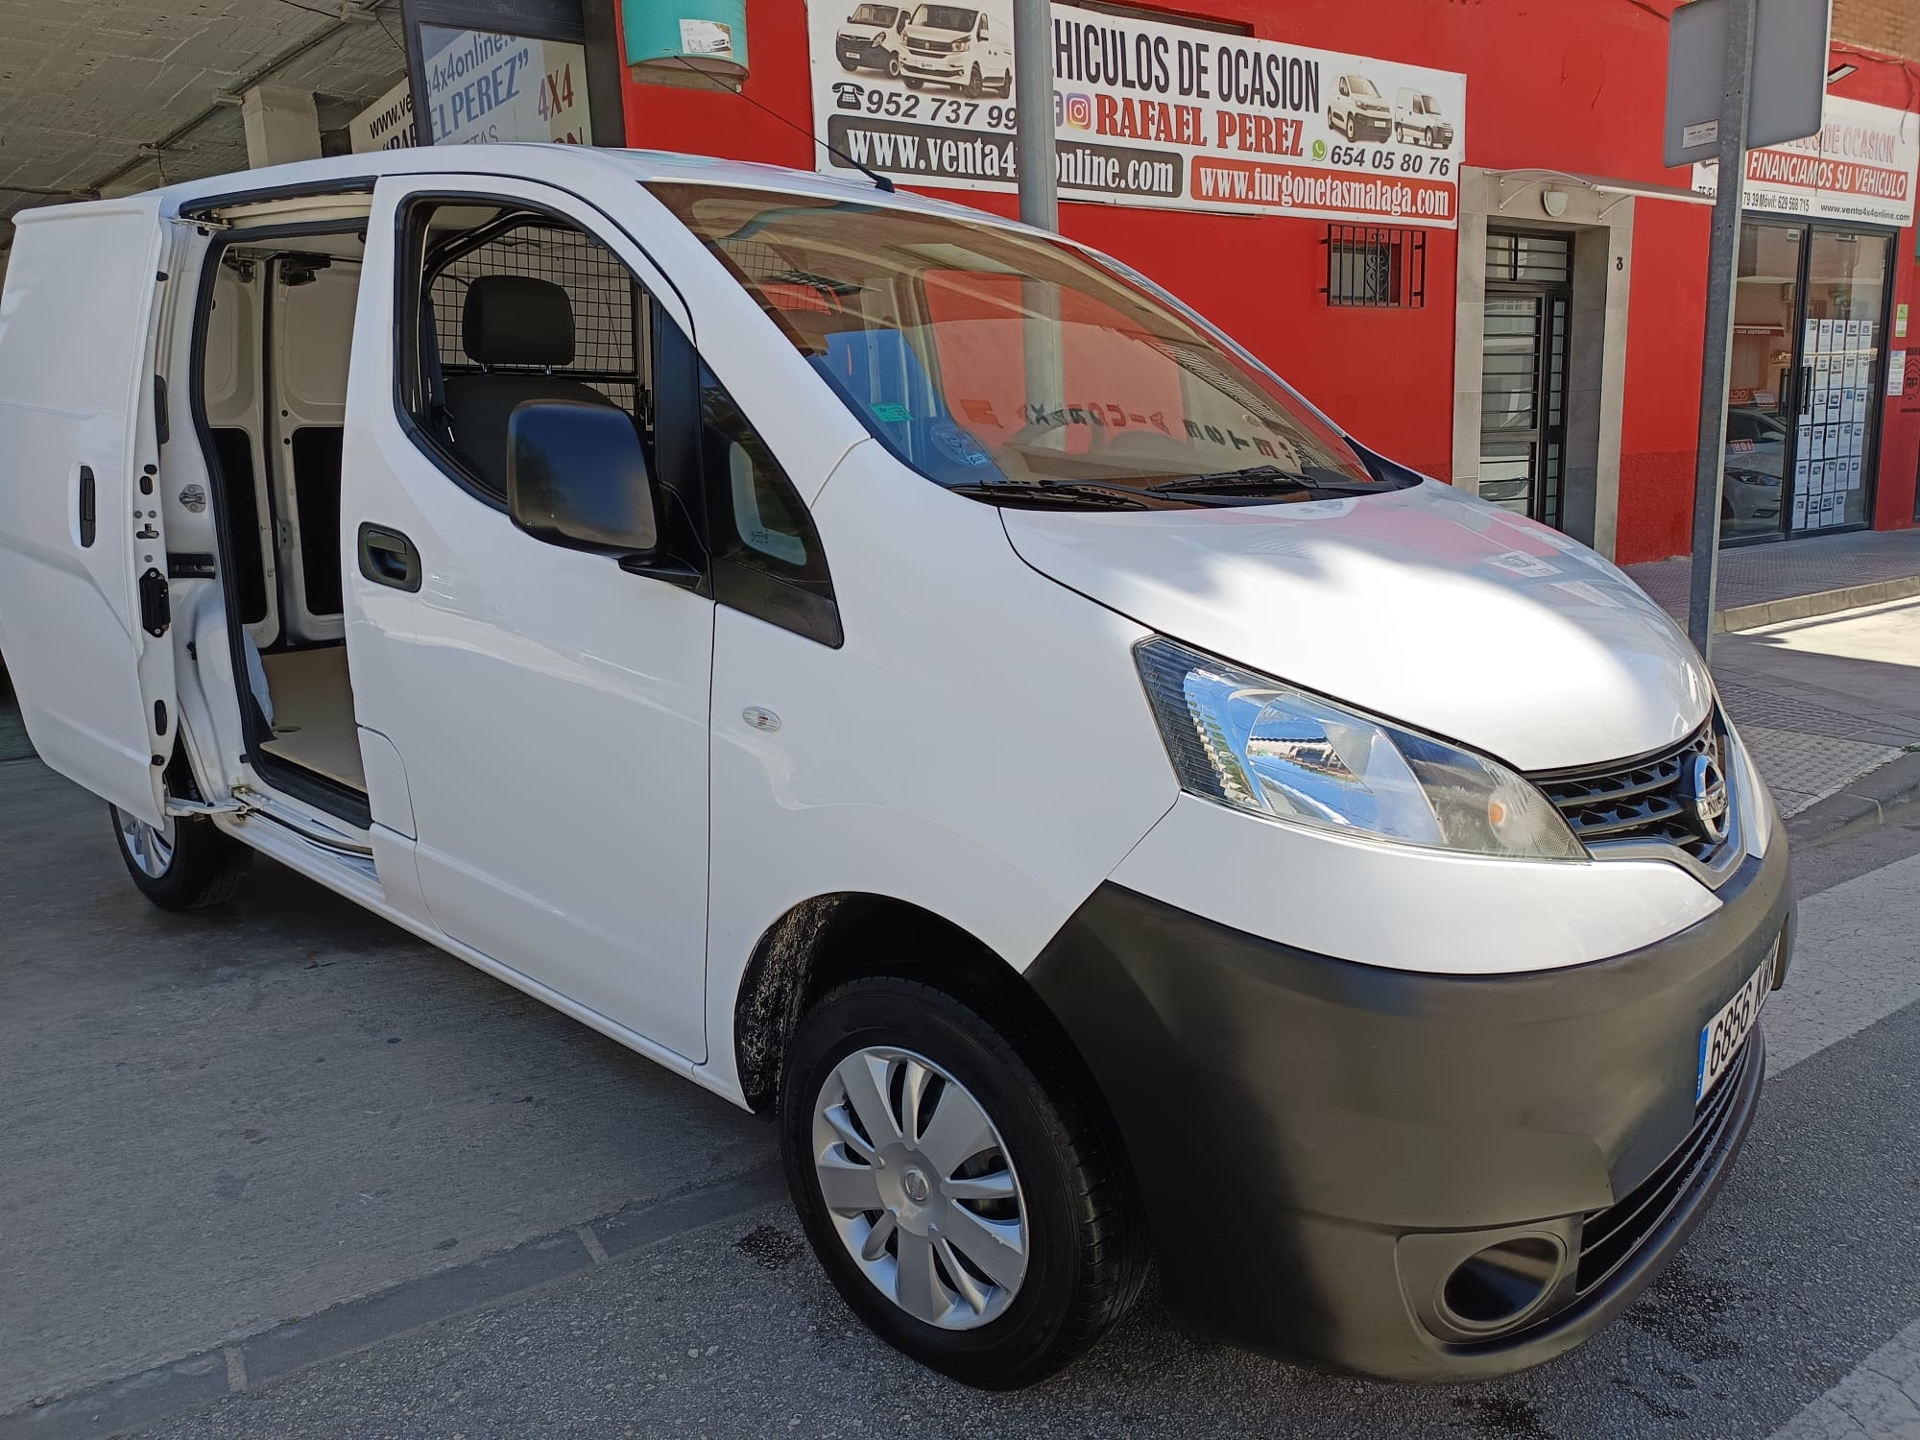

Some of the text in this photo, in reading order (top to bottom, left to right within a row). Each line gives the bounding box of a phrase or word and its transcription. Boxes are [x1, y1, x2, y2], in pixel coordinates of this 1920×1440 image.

[1051, 18, 1320, 114] HICULOS DE OCASION
[538, 62, 574, 122] 4X4
[866, 89, 921, 119] 952
[931, 97, 980, 126] 737
[1095, 93, 1303, 157] RAFAEL PEREZ
[1823, 122, 1840, 154] DE
[1843, 125, 1896, 163] OCASION
[1331, 145, 1450, 176] 654 05 80 76
[1749, 151, 1907, 199] FINANCIAMOS SU VEHICULO
[1199, 166, 1449, 217] www.furgonetasmalaga.com
[1820, 202, 1911, 221] www.venta4x4online.com
[1709, 980, 1753, 1078] 6856
